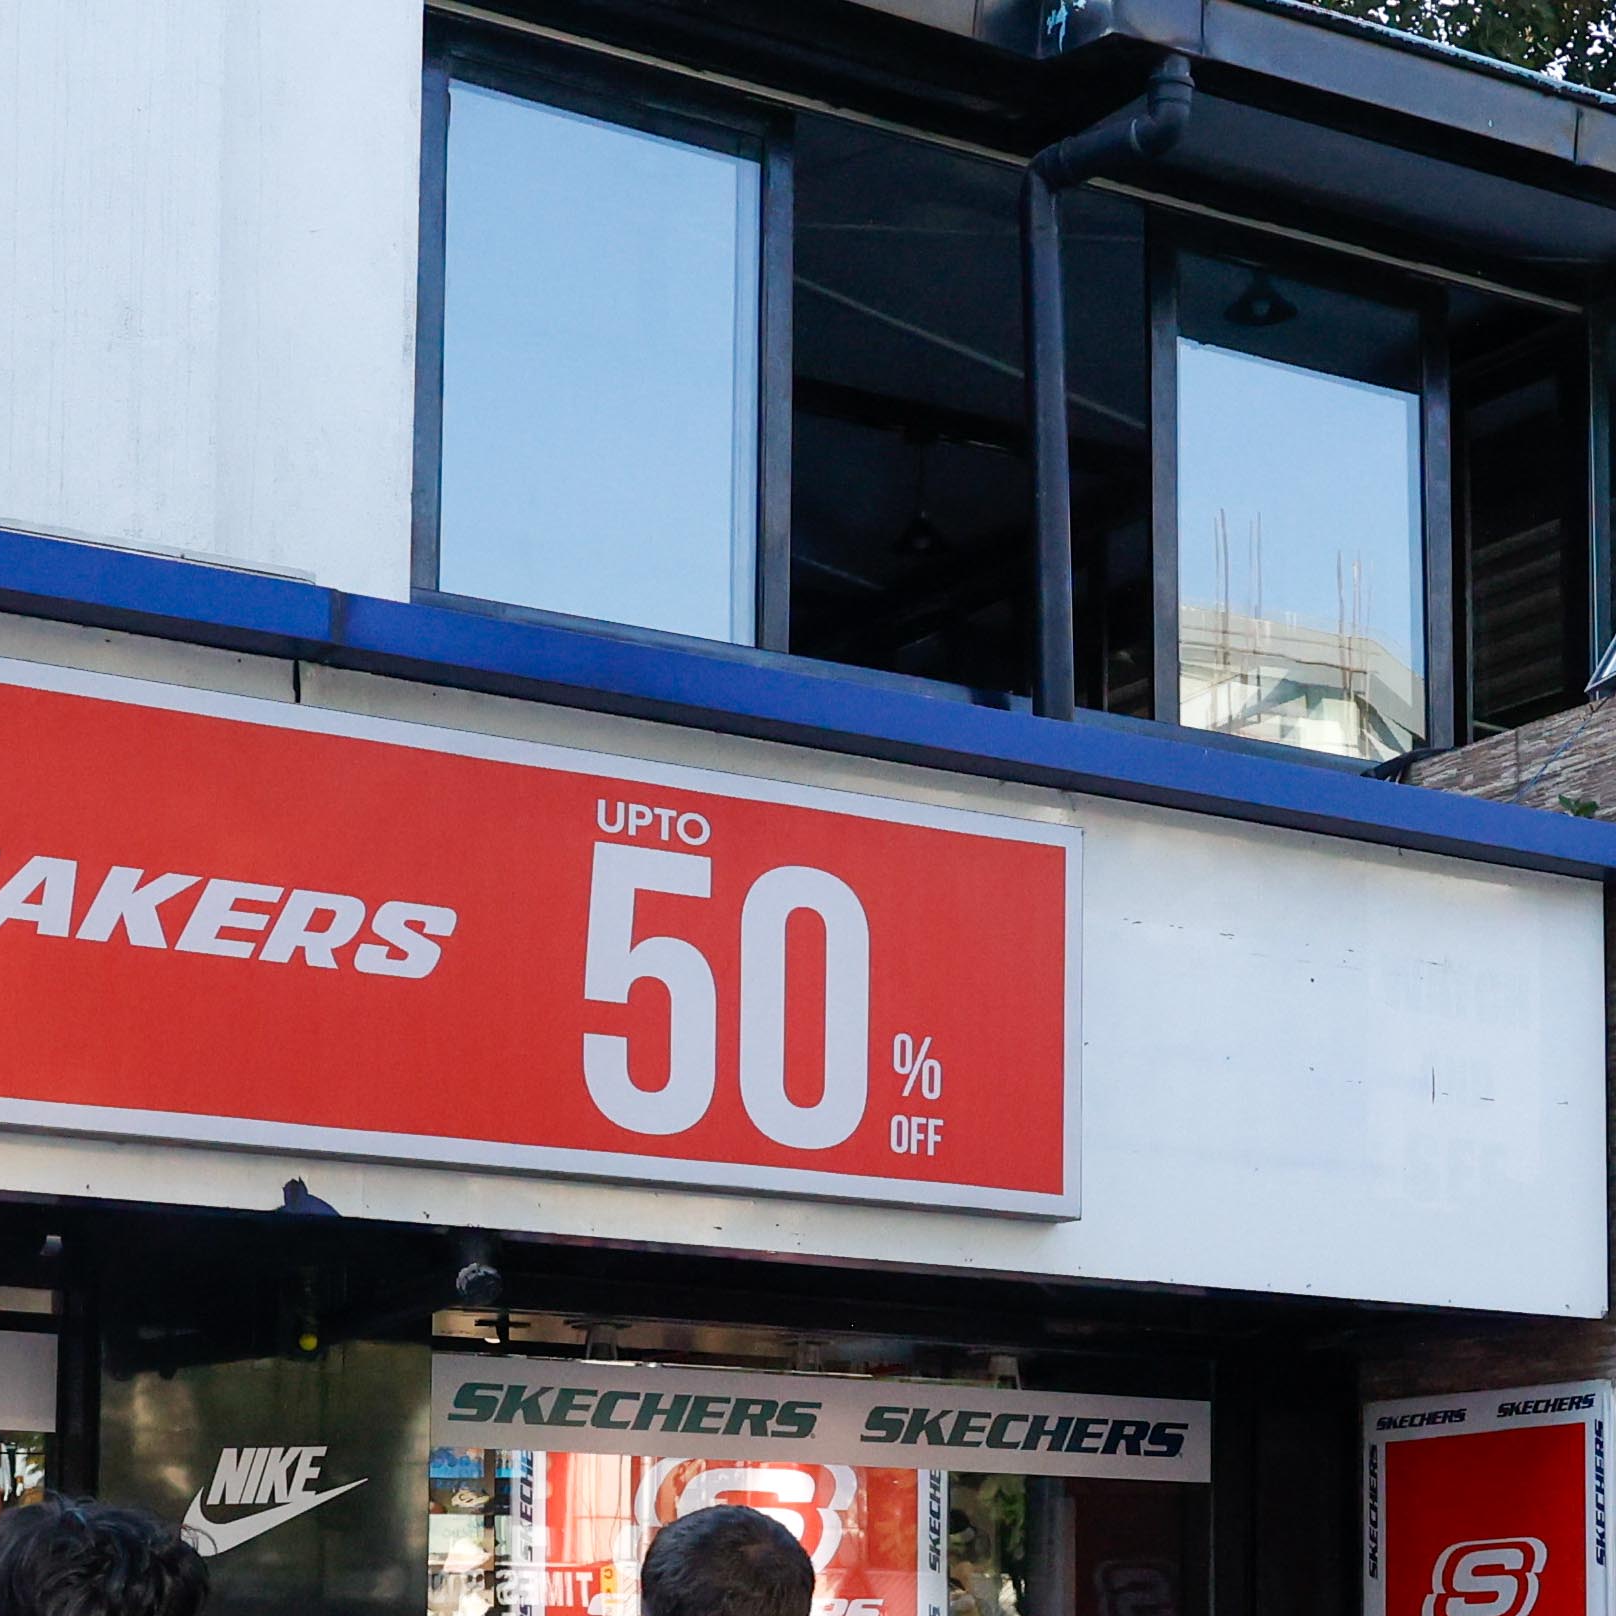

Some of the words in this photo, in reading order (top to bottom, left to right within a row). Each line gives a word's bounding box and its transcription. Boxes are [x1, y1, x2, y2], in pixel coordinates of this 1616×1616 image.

[596, 798, 712, 846] UPTO
[582, 840, 872, 1152] 50
[891, 1032, 942, 1102] %
[888, 1113, 944, 1157] OFF
[447, 1380, 822, 1440] SKECHERS
[860, 1405, 1189, 1458] SKECHERS
[1376, 1408, 1466, 1431] SKECHERS
[1497, 1393, 1595, 1419] SKECHERS
[207, 1446, 328, 1505] NIKE
[520, 1451, 533, 1562] SKECHE
[1368, 1445, 1380, 1580] SKECHERS
[1595, 1418, 1604, 1567] SKECHERS
[929, 1470, 941, 1573] SKECHE
